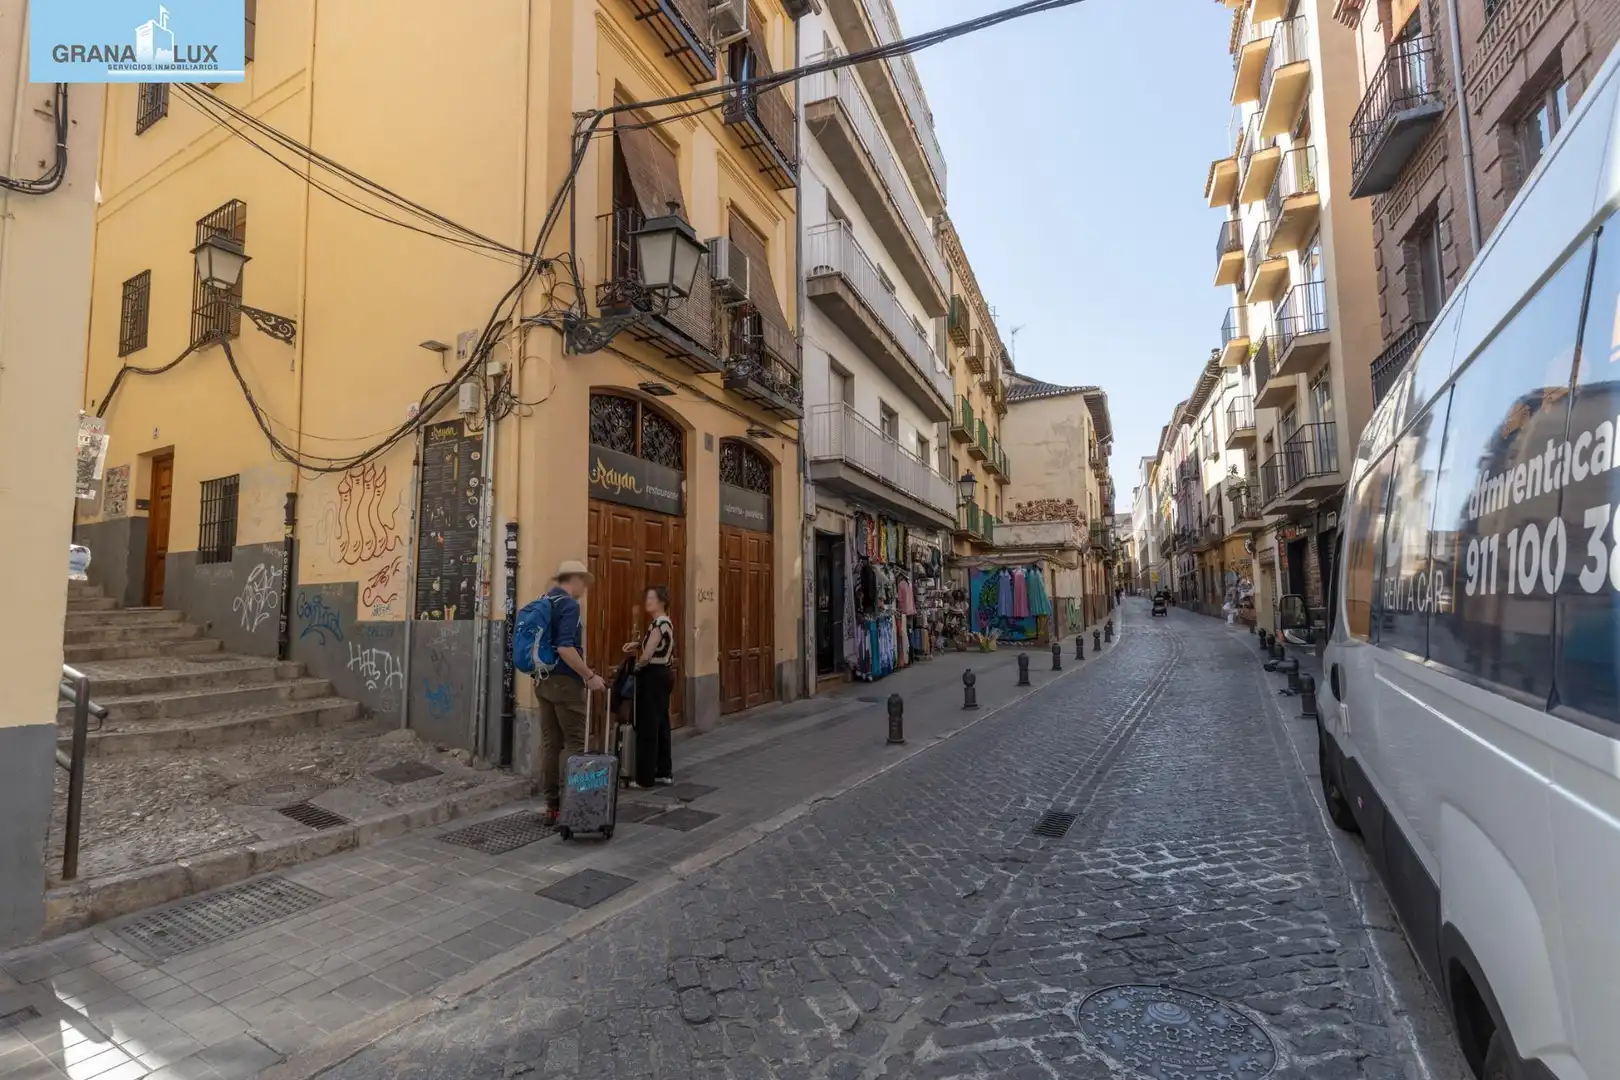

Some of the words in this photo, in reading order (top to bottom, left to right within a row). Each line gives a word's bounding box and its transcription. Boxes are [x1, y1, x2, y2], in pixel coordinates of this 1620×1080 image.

[589, 456, 643, 495] Rayan
[1465, 533, 1500, 597] 911
[1507, 516, 1567, 596] 100
[1383, 575, 1404, 612] RENT
[1406, 575, 1415, 612] A
[1417, 568, 1444, 614] CAR
